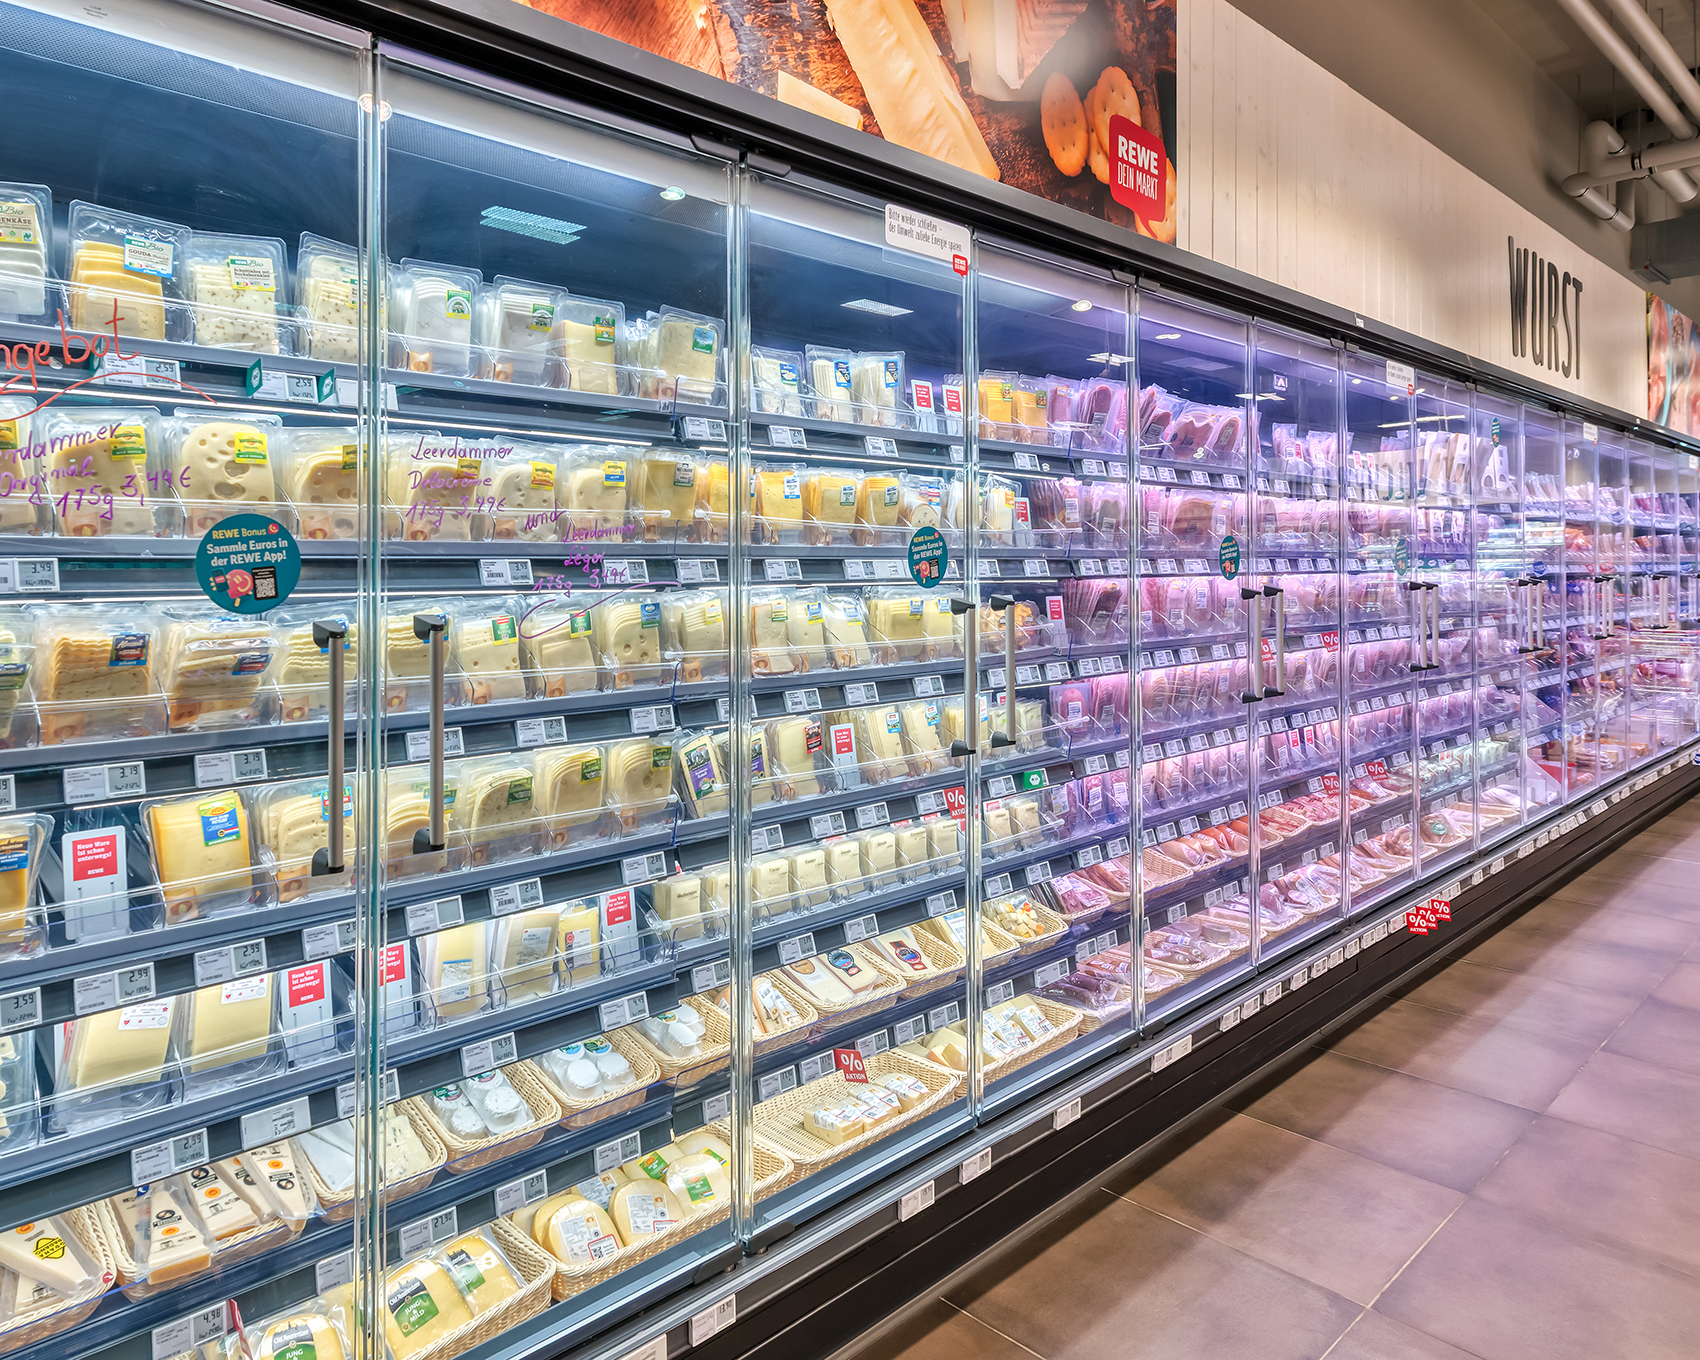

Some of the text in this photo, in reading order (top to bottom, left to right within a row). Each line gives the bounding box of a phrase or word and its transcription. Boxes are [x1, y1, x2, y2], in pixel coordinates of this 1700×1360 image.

[1118, 134, 1158, 175] REWE
[1118, 161, 1158, 200] DEIN MARKT
[888, 208, 900, 222] Bitte
[902, 212, 916, 226] wieder
[918, 218, 938, 232] schließen
[897, 224, 914, 239] Umwelt
[915, 228, 930, 244] zuliebe
[931, 234, 947, 250] Energie
[128, 248, 152, 258] GOUDA
[1508, 235, 1583, 380] WURST
[411, 436, 514, 460] Leerdammer
[56, 485, 113, 520] 175g
[405, 500, 444, 528] 175g
[212, 527, 266, 539] REWE Bonus
[206, 538, 288, 554] Sammle Euros in
[211, 550, 287, 566] der REWE App!
[921, 551, 932, 559] REWE
[31, 562, 51, 574] 3.49
[243, 752, 260, 764] 3.19
[120, 766, 138, 778] 3.19
[77, 852, 112, 862] unterwegs!
[1409, 915, 1426, 926] %
[243, 944, 259, 957] 2.99
[129, 968, 148, 982] 2.99
[13, 993, 34, 1009] 3.59
[840, 1053, 863, 1071] %
[184, 1134, 201, 1149] 2.99
[405, 1301, 420, 1314] JUNG
[203, 1308, 221, 1323] 4.98
[410, 1309, 424, 1322] MILD
[284, 1330, 310, 1342] Amsterdam
[286, 1349, 303, 1360] JUNG
